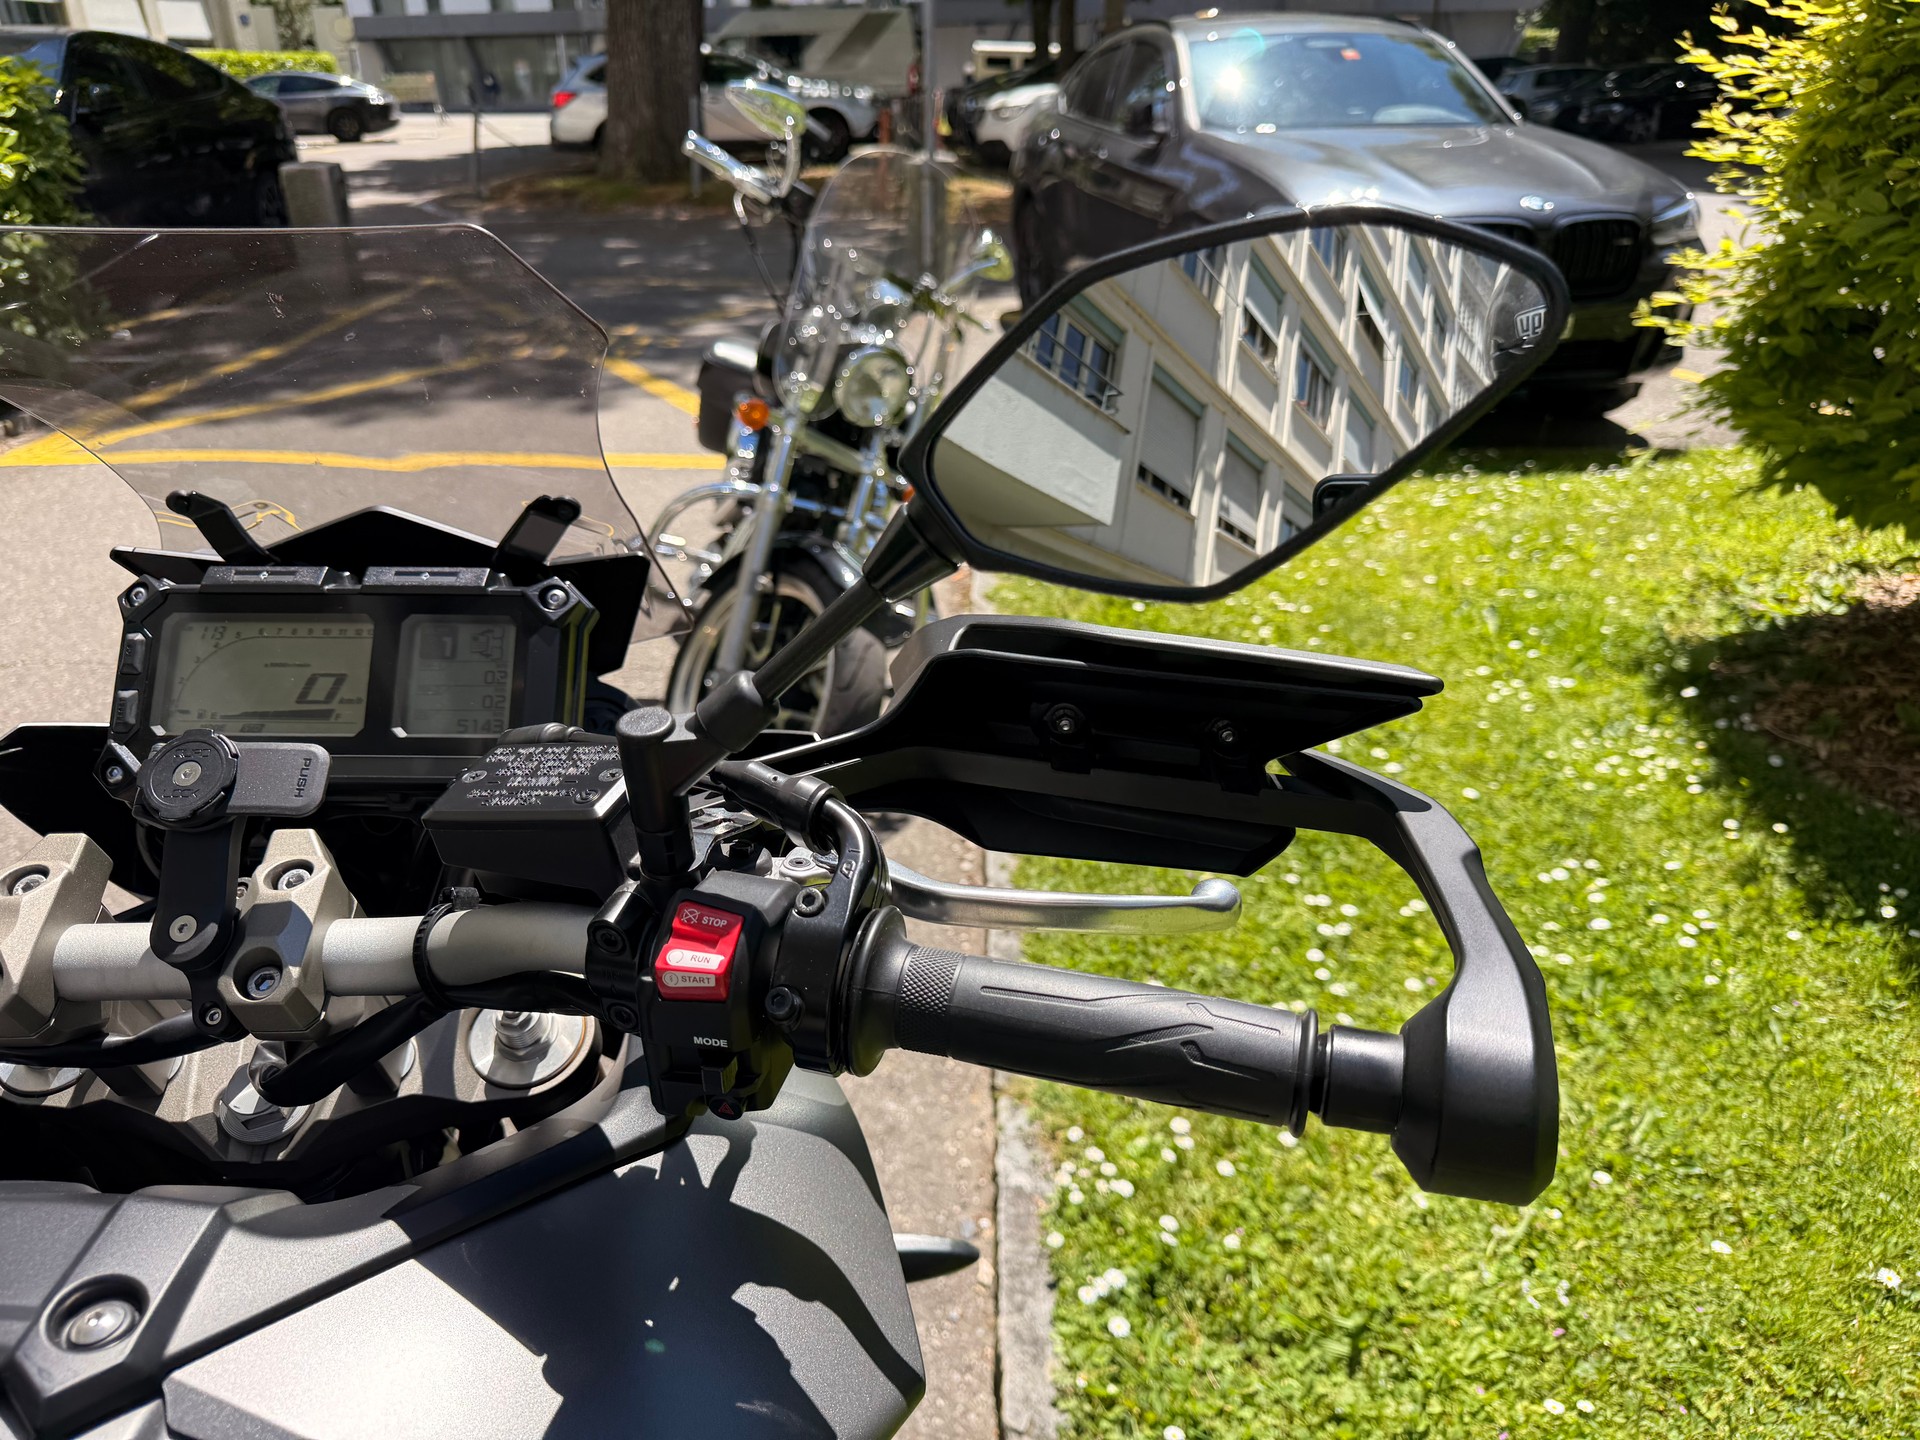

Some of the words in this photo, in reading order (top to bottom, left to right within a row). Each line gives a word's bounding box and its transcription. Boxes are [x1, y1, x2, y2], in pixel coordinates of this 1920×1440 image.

[295, 672, 349, 705] 0
[293, 757, 313, 799] PUSH
[701, 915, 728, 928] STOP
[690, 954, 712, 964] RUN
[681, 975, 712, 985] START
[693, 1036, 728, 1048] MODE
